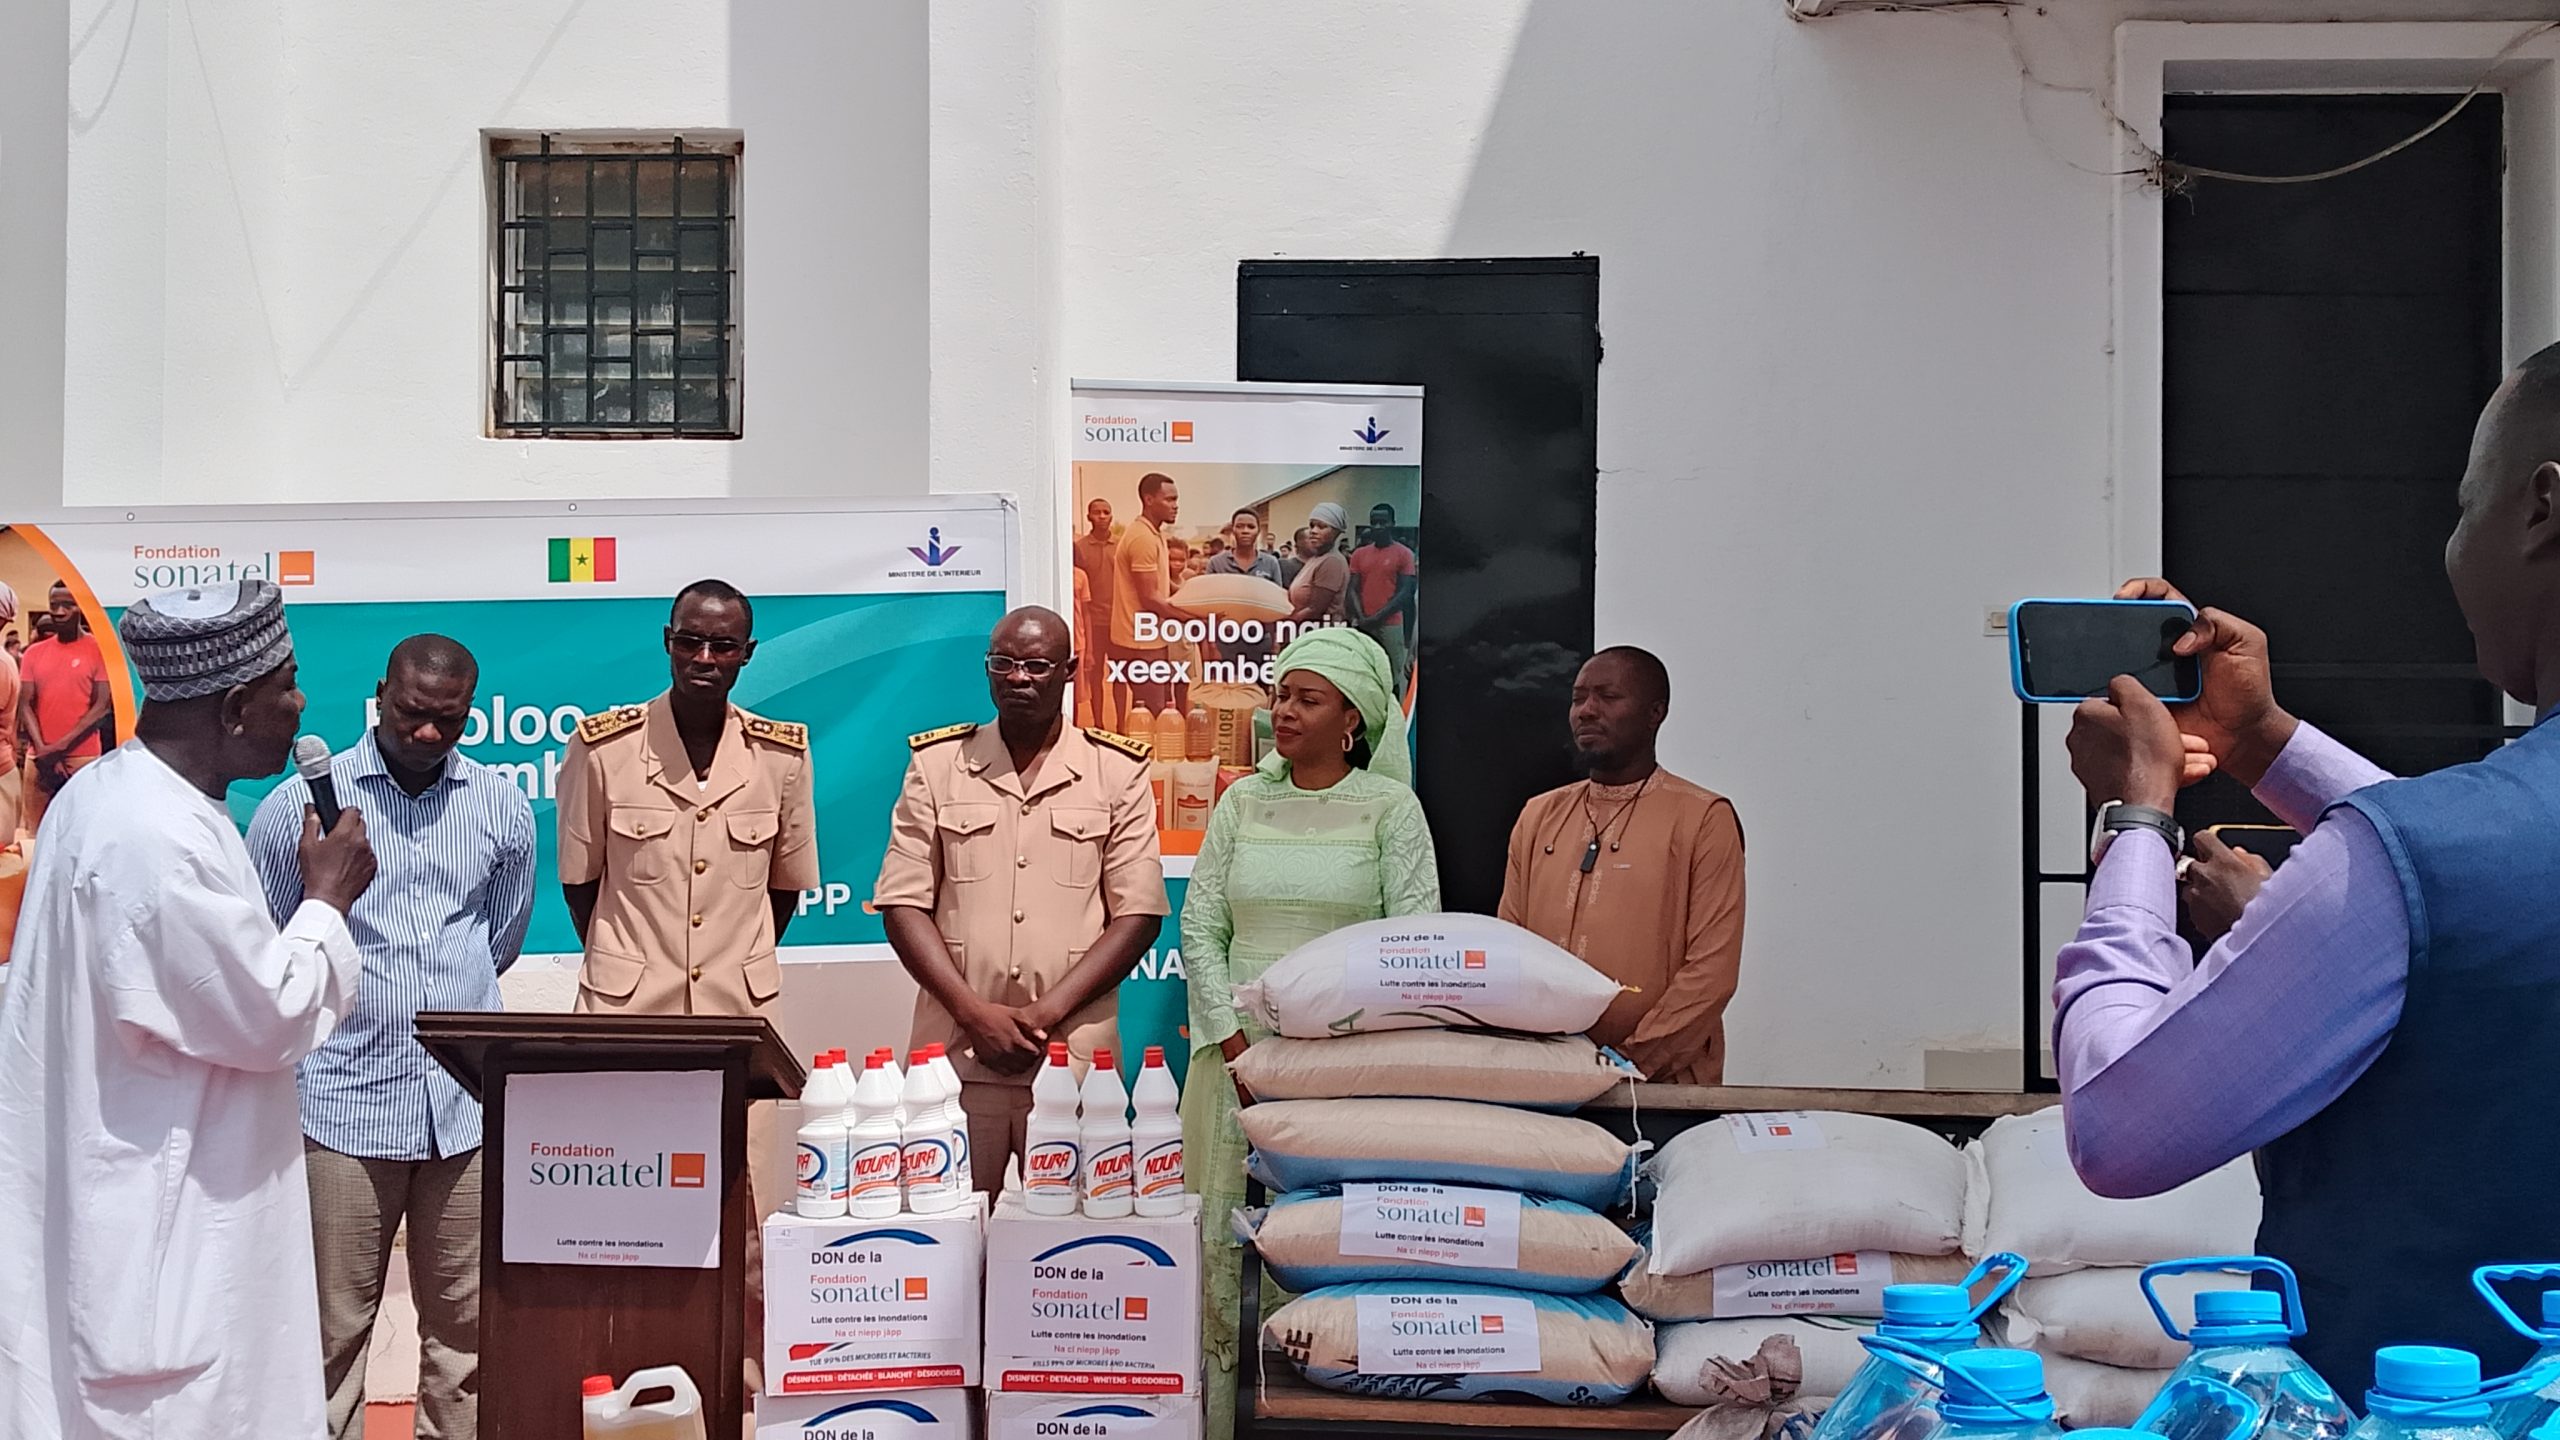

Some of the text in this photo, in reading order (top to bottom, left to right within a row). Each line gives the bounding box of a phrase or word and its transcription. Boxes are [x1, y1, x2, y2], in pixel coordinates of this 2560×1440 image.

[1085, 415, 1137, 424] Fondation
[1085, 421, 1167, 442] sonatel
[134, 545, 220, 559] Fondation
[134, 552, 270, 589] sonatel
[1133, 612, 1263, 643] Booloo
[1107, 654, 1275, 683] xeex mbë
[1380, 950, 1460, 969] sonatel
[1401, 980, 1426, 988] contre
[530, 1142, 614, 1157] Fondation
[530, 1152, 663, 1188] sonatel
[1376, 1196, 1429, 1206] Fondation
[1376, 1205, 1460, 1226] sonatel
[557, 1238, 663, 1248] Lutte contre les inondations
[1375, 1231, 1396, 1240] Lutte
[1398, 1234, 1422, 1242] contre
[1424, 1234, 1436, 1243] les
[811, 1251, 882, 1265] DON de la
[1034, 1266, 1104, 1280] DON de la
[1747, 1256, 1831, 1280] sonatel
[810, 1274, 867, 1284] Fondation
[810, 1278, 899, 1304] sonatel
[1032, 1288, 1088, 1300] Fondation
[1748, 1290, 1769, 1298] Lutte
[1771, 1289, 1796, 1297] contre
[1390, 1297, 1458, 1305] DON de la
[1031, 1297, 1120, 1320] sonatel
[1391, 1311, 1445, 1319] Fondation
[811, 1316, 833, 1324] Lutte
[835, 1315, 862, 1324] contre
[878, 1314, 928, 1322] inondations
[1392, 1315, 1477, 1336] sonatel
[1031, 1330, 1147, 1341] Lutte contre les inondations
[1393, 1348, 1414, 1356] Lutte
[1443, 1347, 1456, 1355] les
[1457, 1346, 1505, 1354] inondations
[809, 1359, 822, 1367] TUE
[842, 1355, 854, 1363] DES
[855, 1352, 888, 1361] MICROBES
[1125, 1361, 1155, 1369] BACTERIA
[1006, 1374, 1179, 1386] DISINFECT DETACHED WHITENS DEODORIZES
[804, 1428, 874, 1440] DON de la
[1036, 1422, 1107, 1436] DON de la
